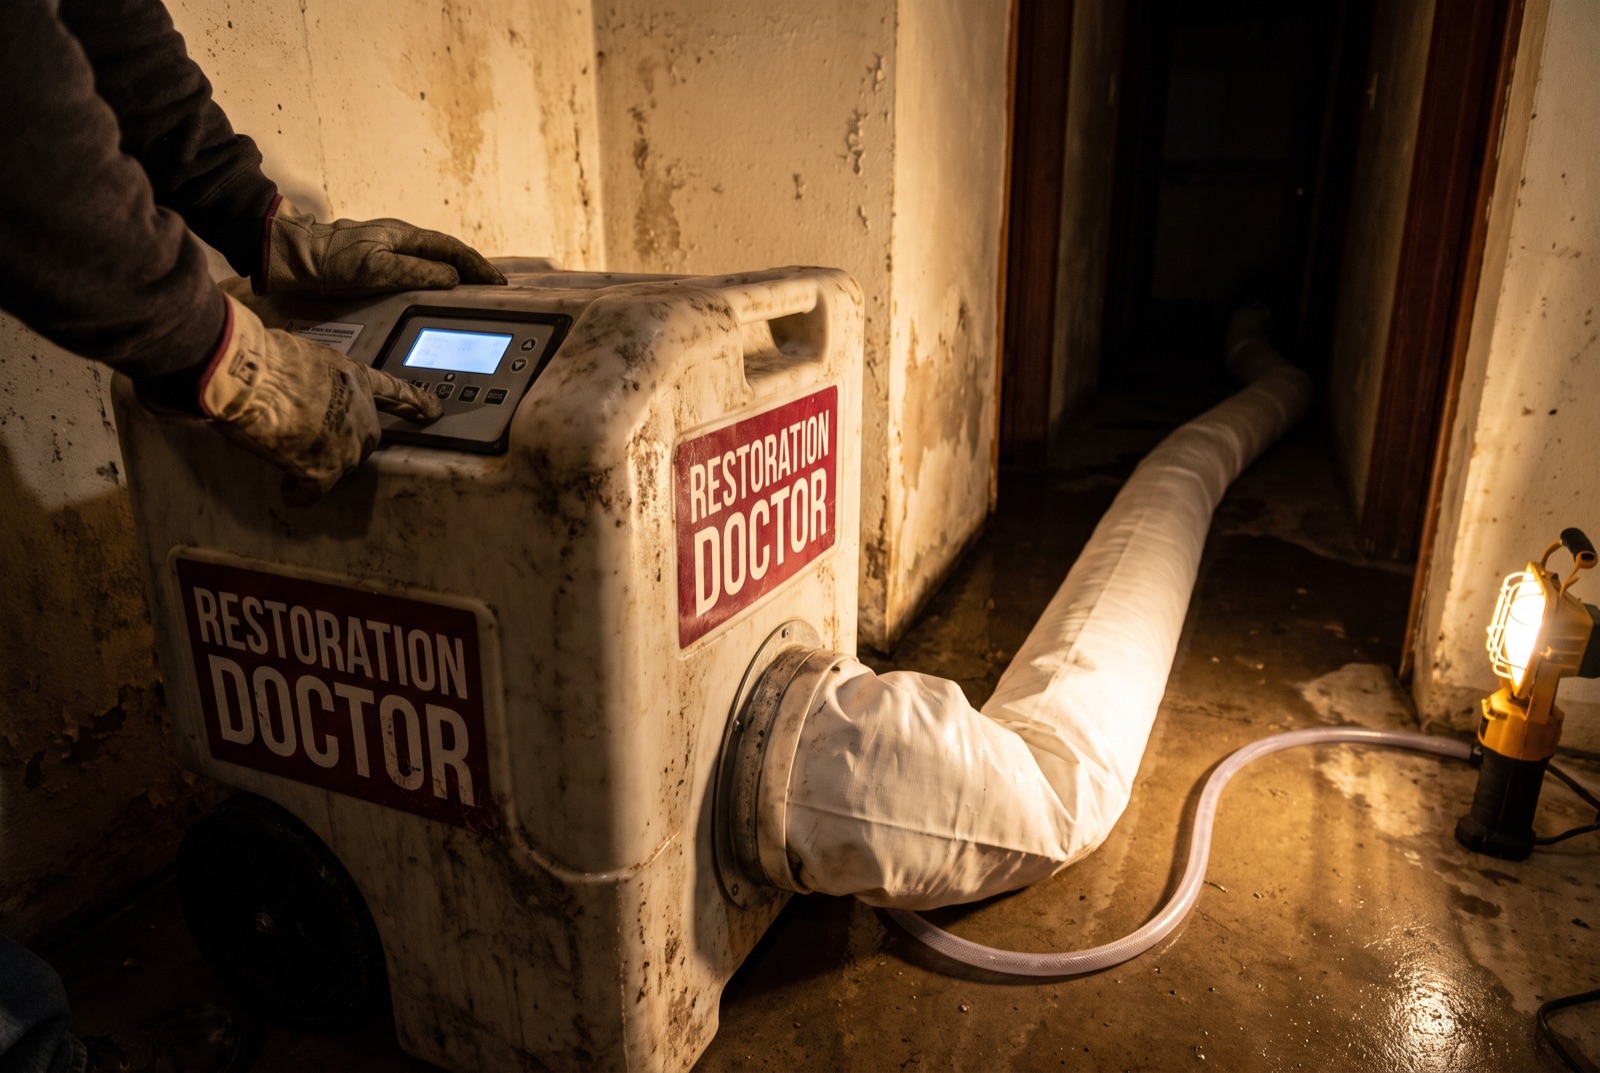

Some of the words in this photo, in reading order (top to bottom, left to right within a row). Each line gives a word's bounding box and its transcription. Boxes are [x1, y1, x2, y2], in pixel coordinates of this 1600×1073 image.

[690, 410, 829, 524] RESTORATION
[694, 467, 827, 618] DOCTOR
[193, 586, 468, 700] RESTORATION
[208, 653, 475, 808] DOCTOR
